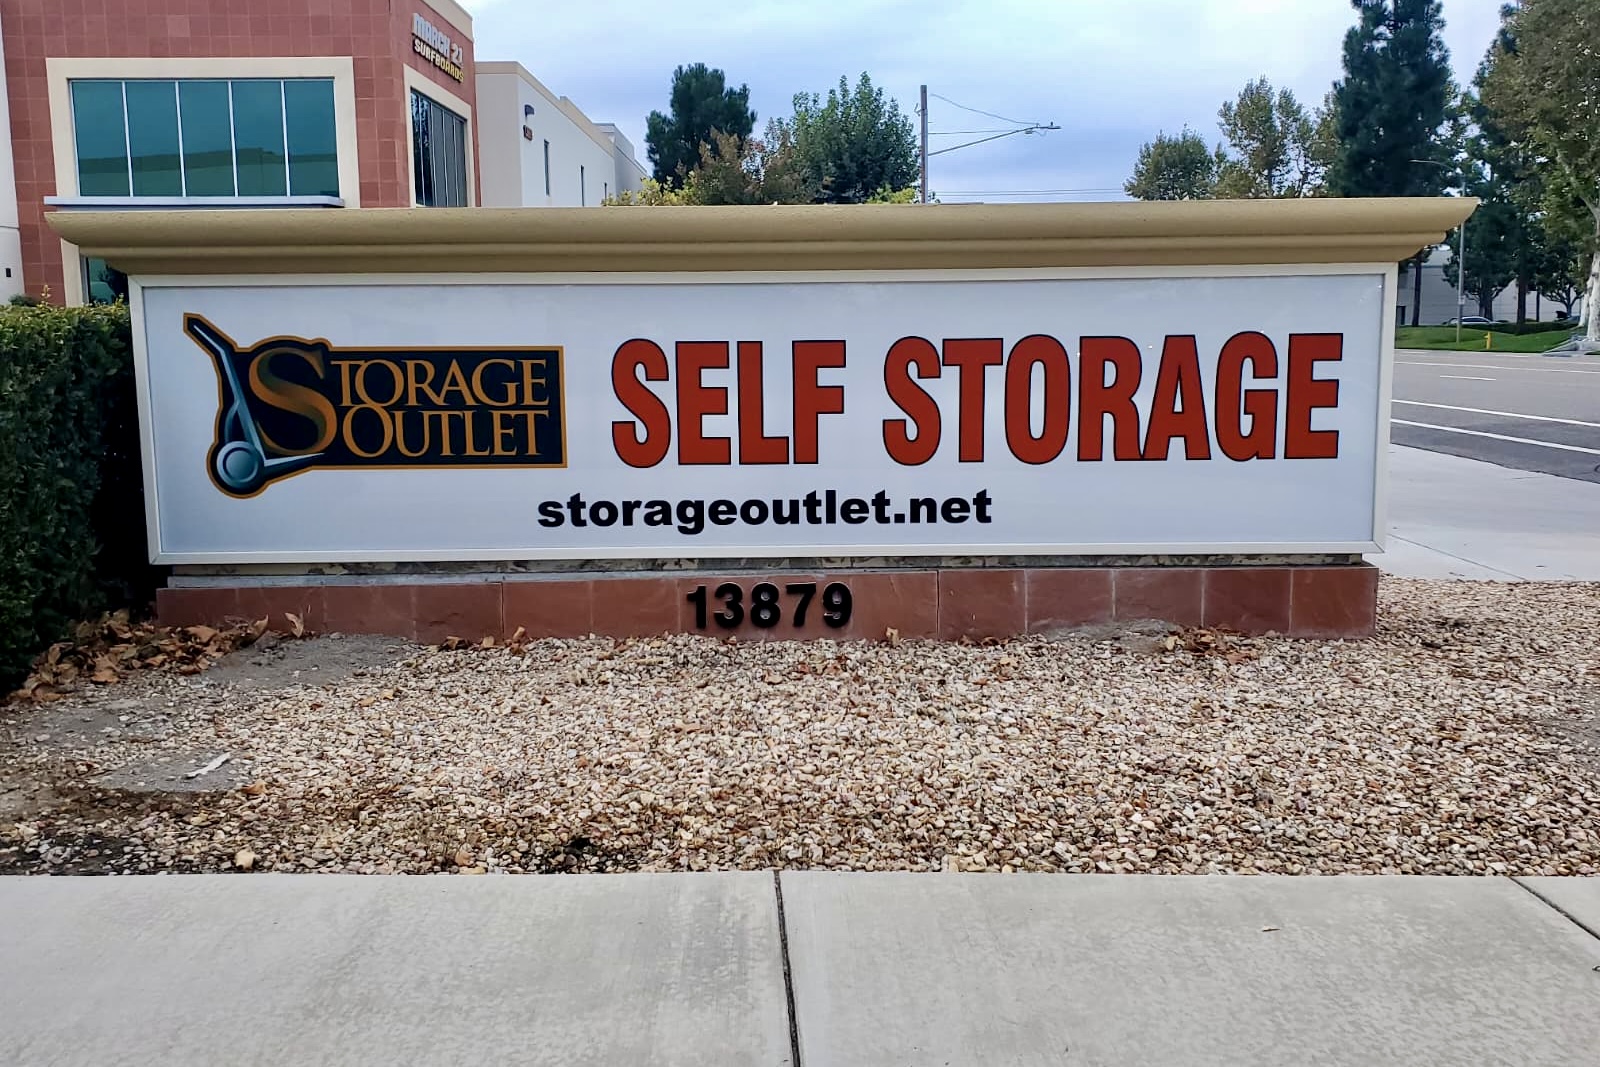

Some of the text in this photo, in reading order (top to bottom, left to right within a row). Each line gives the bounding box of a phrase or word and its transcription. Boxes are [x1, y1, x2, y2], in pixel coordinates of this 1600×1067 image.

[411, 12, 463, 65] MARCH 21
[413, 38, 464, 83] SURFBOARDS
[249, 346, 550, 454] STORAGE
[611, 331, 1344, 468] SELF STORAGE
[342, 404, 549, 458] OUTLET
[538, 489, 992, 534] storageoutlet.net
[686, 582, 853, 630] 13879
